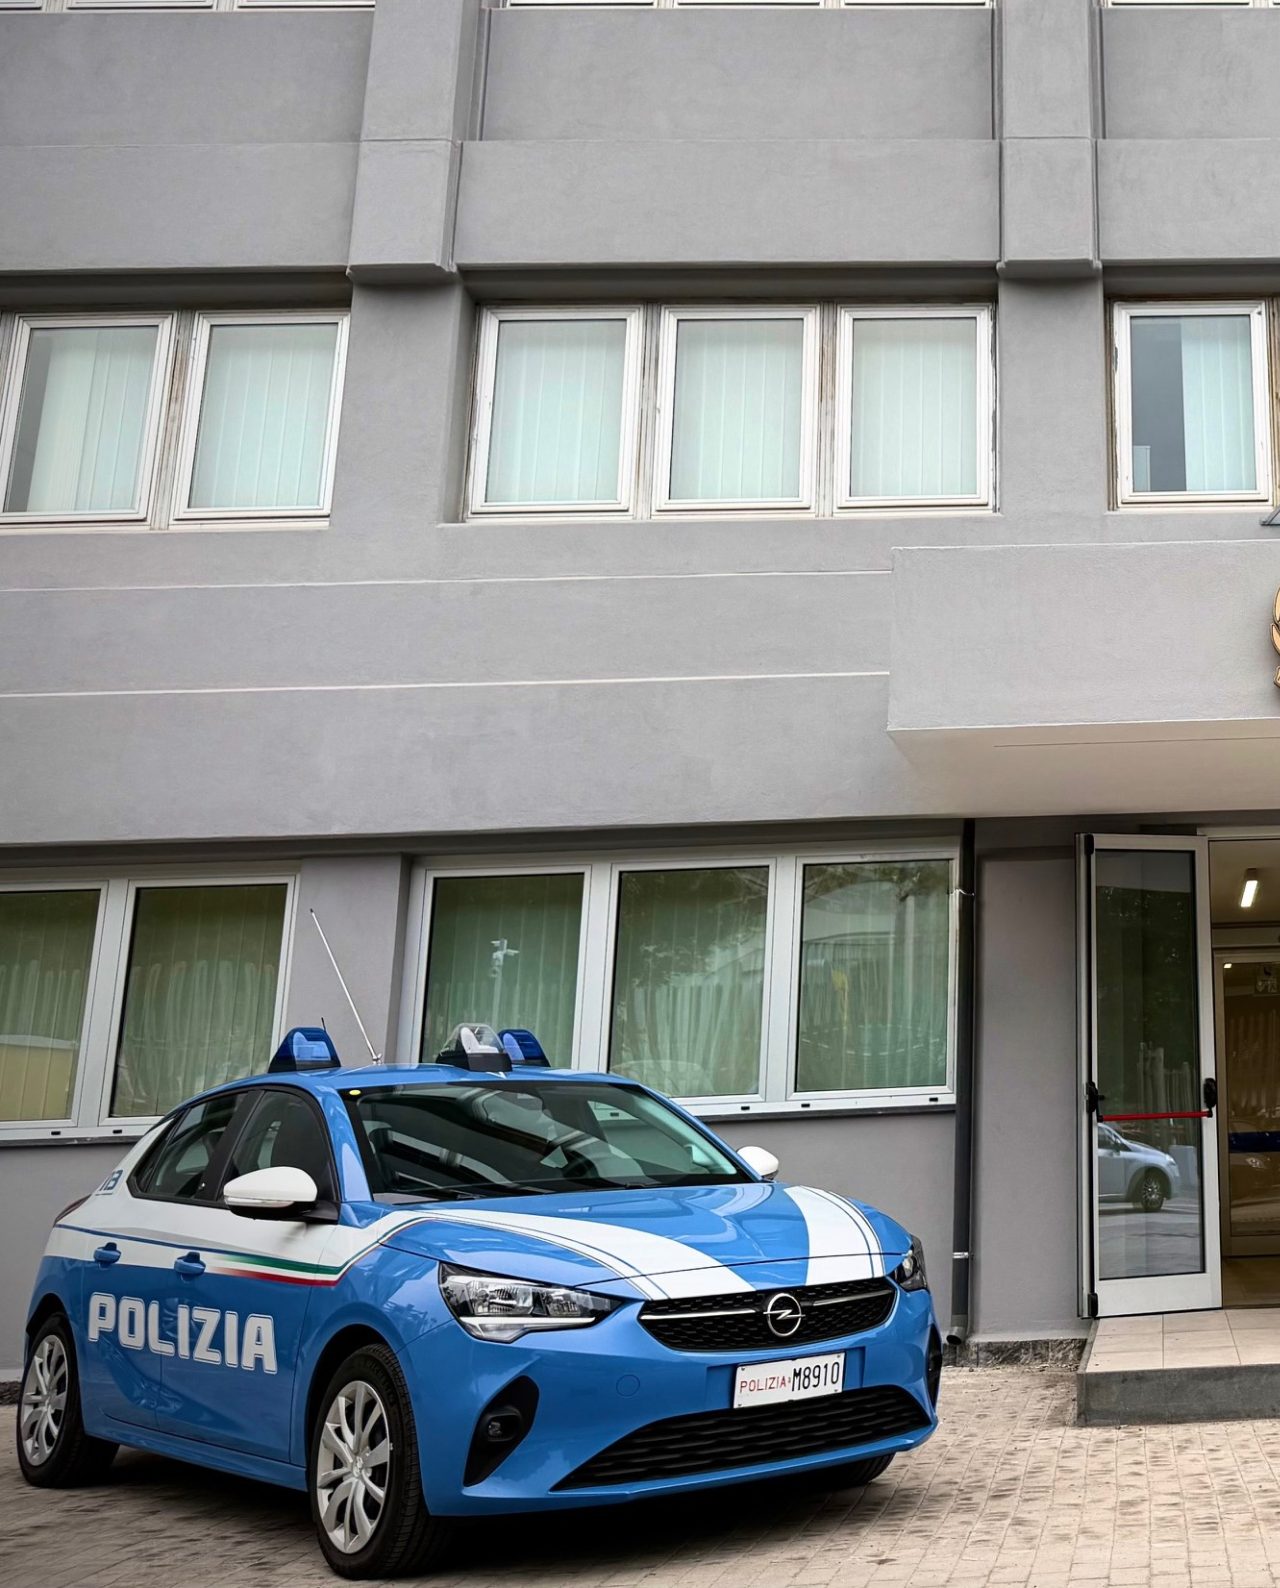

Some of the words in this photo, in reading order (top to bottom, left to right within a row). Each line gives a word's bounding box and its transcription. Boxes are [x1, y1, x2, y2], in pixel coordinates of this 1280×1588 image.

[88, 1292, 278, 1375] POLIZIA
[740, 1376, 787, 1393] POLIZIA
[792, 1362, 840, 1392] M8910
